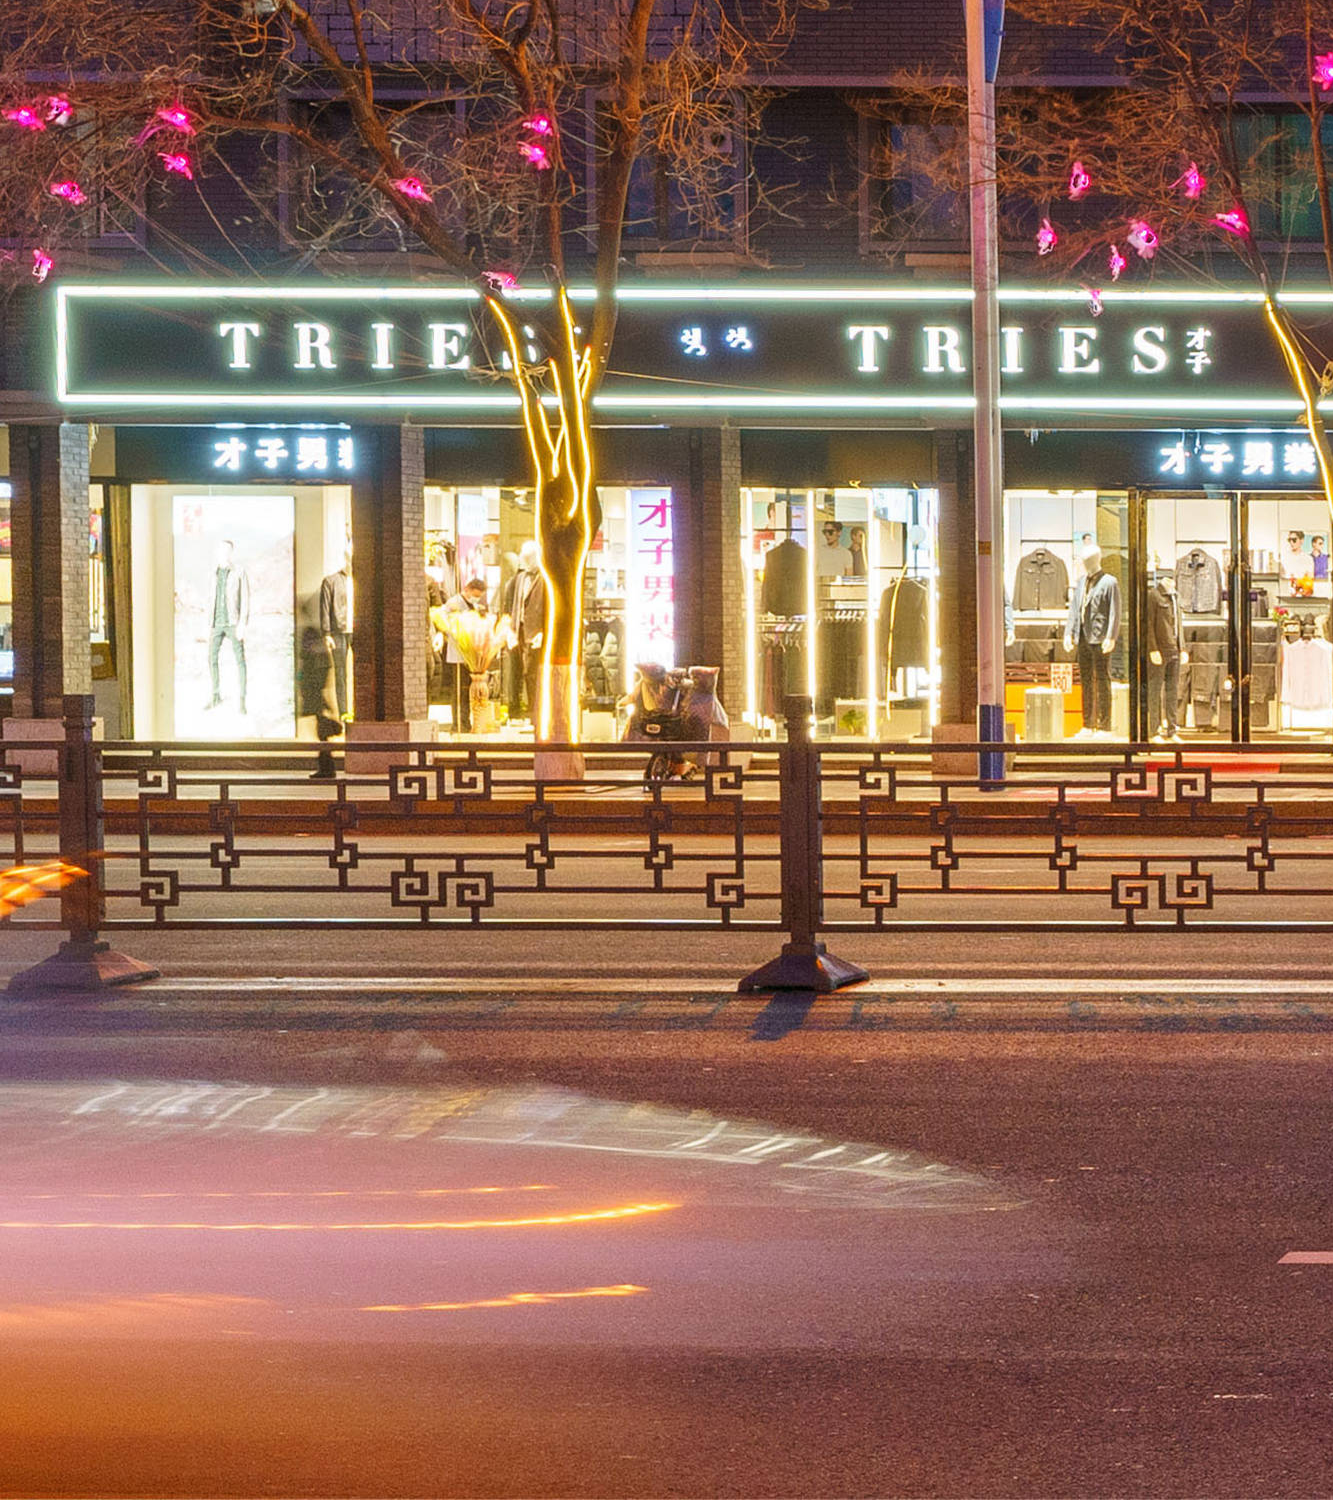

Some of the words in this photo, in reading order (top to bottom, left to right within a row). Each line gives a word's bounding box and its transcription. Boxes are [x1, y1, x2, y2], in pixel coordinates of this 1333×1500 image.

[848, 325, 1168, 373] TRIES
[1185, 326, 1212, 375] 才子
[1160, 440, 1317, 475] 才子男装
